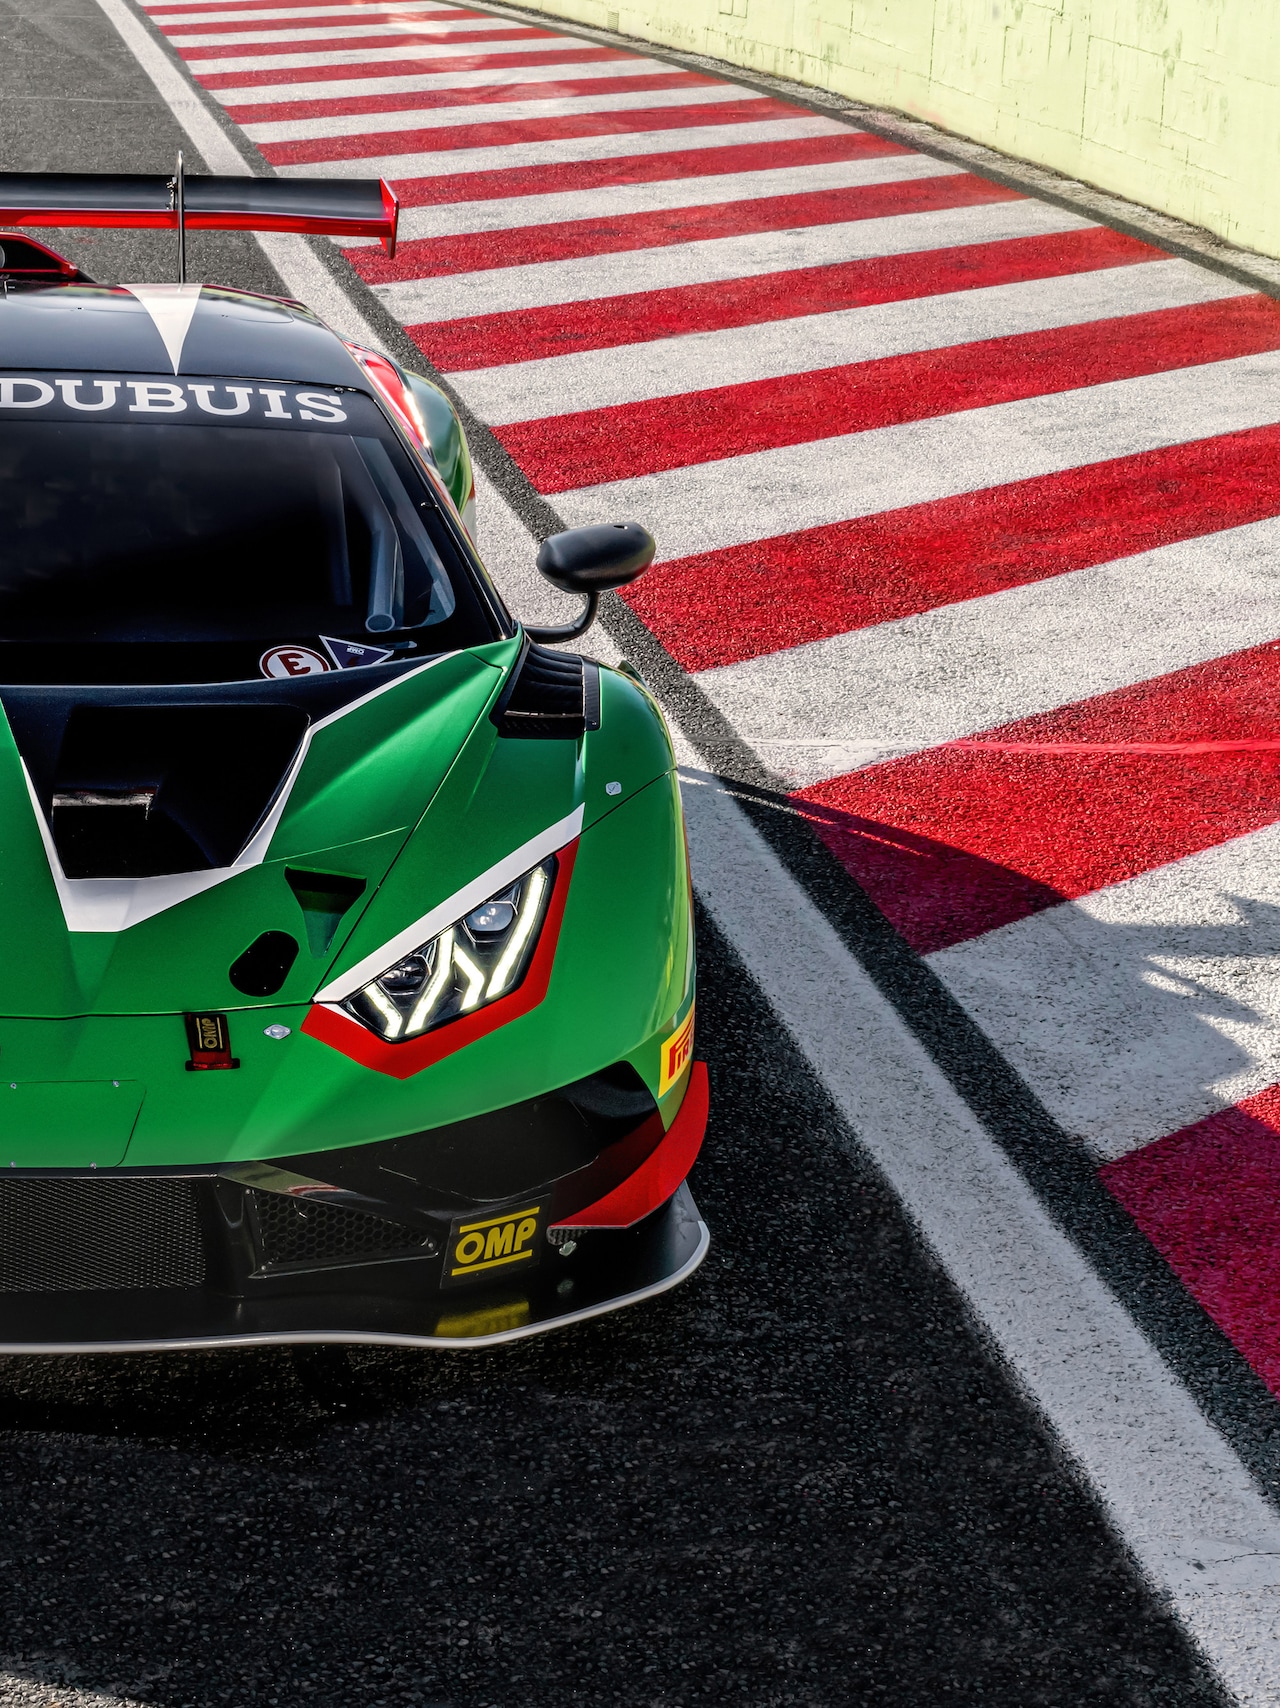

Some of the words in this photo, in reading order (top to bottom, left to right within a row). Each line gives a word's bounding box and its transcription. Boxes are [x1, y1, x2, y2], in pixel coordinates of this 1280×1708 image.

[277, 652, 311, 677] E
[201, 1017, 218, 1049] OMP
[455, 1217, 537, 1264] OMP
